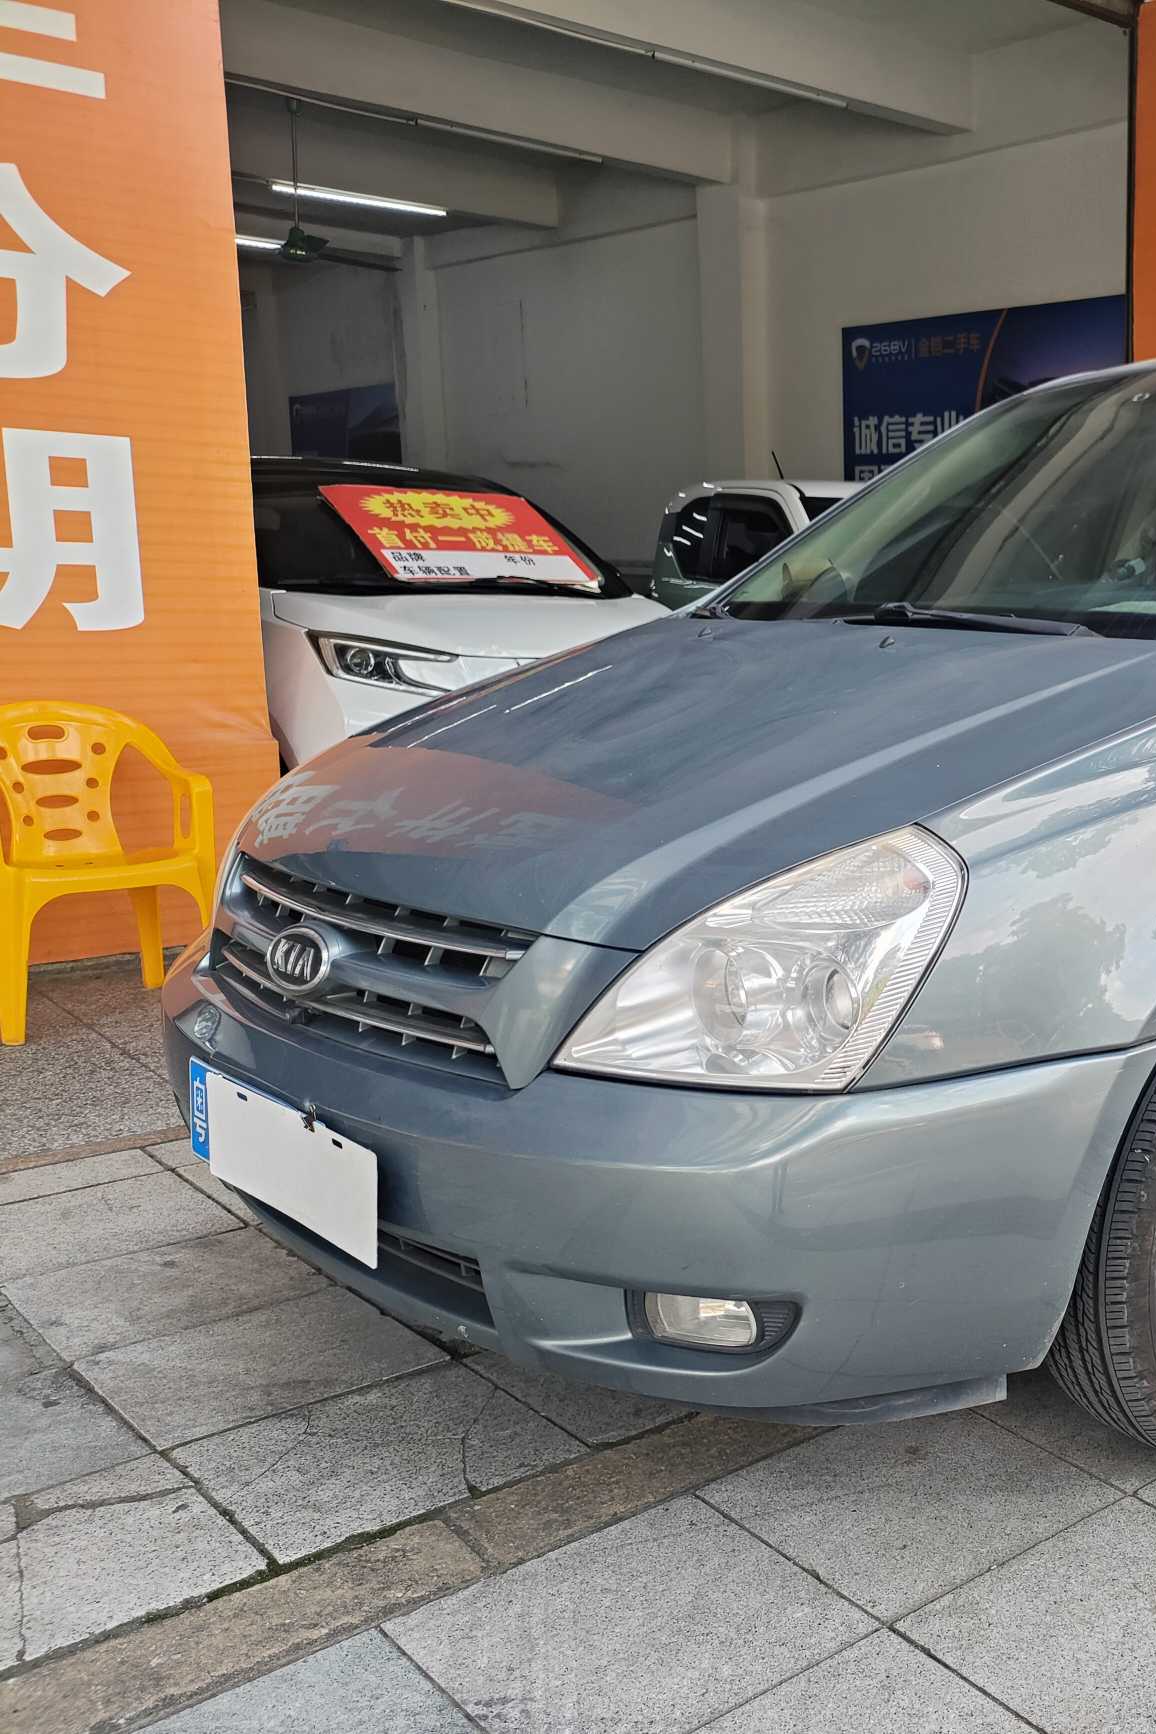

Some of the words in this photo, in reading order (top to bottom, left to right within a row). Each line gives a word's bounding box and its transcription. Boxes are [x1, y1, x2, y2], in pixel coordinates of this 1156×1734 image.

[382, 498, 497, 523] 热卖中
[367, 526, 560, 554] 首付一成提车
[391, 551, 425, 563] 品牌
[273, 938, 315, 981] KIA
